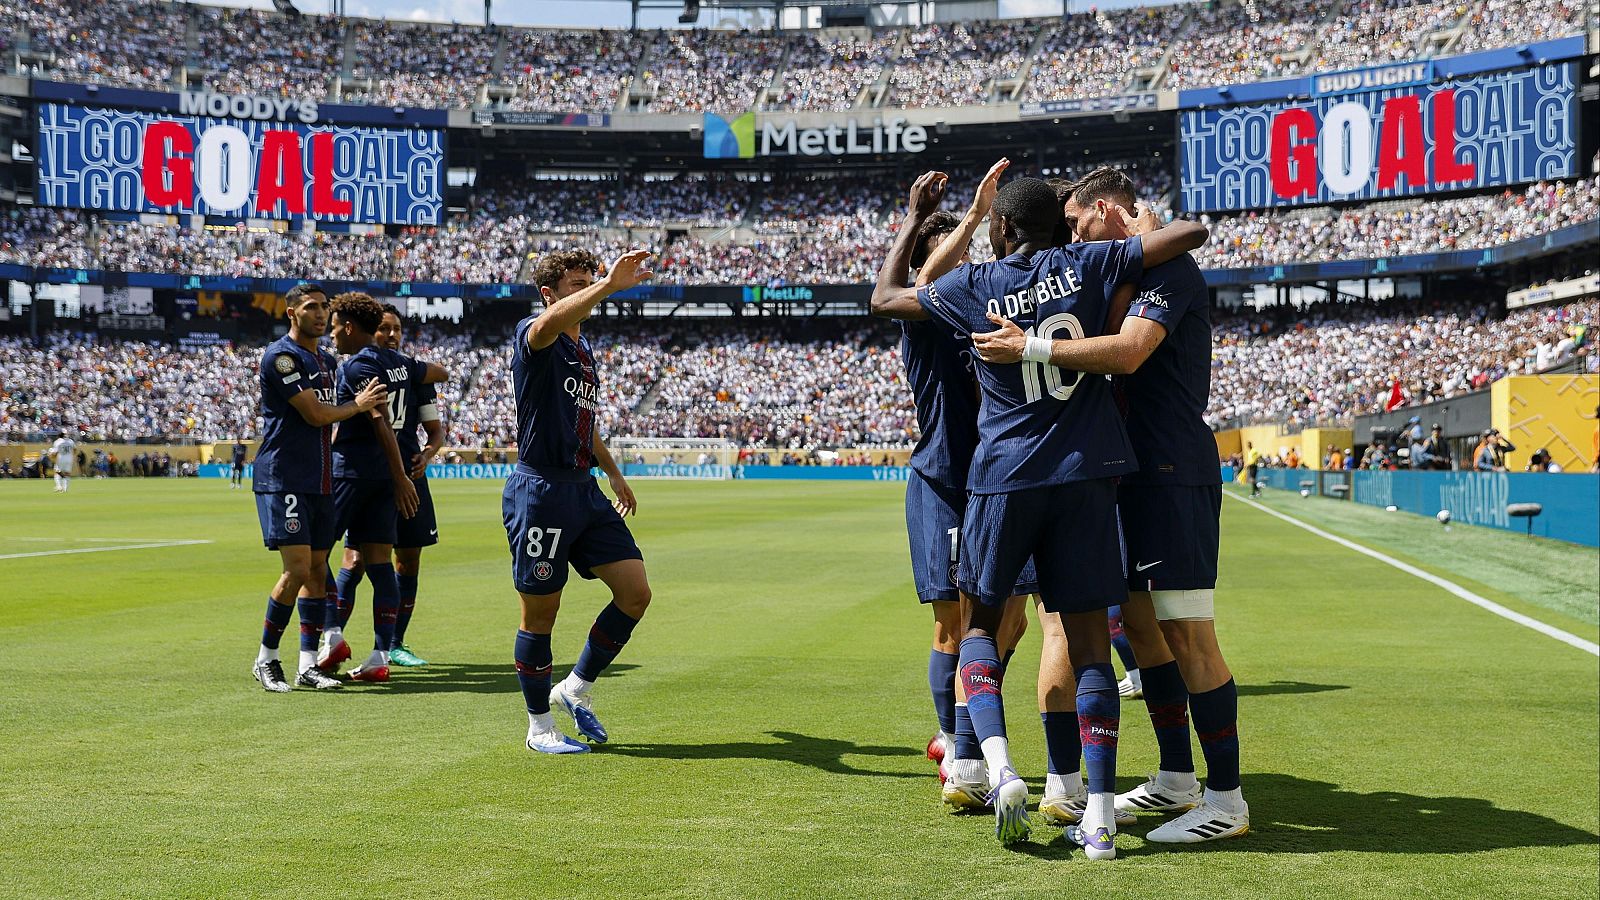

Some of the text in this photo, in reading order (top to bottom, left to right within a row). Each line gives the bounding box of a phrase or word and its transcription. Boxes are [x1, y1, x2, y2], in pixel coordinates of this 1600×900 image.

[1319, 64, 1425, 93] BUD LIGHT
[179, 91, 319, 123] MOODY'S
[761, 117, 928, 156] MetLife
[1270, 89, 1476, 199] GOAL
[141, 120, 353, 216] GOAL
[763, 286, 813, 301] MetLife
[1022, 313, 1088, 404] 10
[284, 493, 298, 518] 2
[526, 526, 562, 559] 87
[970, 674, 999, 688] PARIS
[1091, 726, 1119, 738] PARIS
